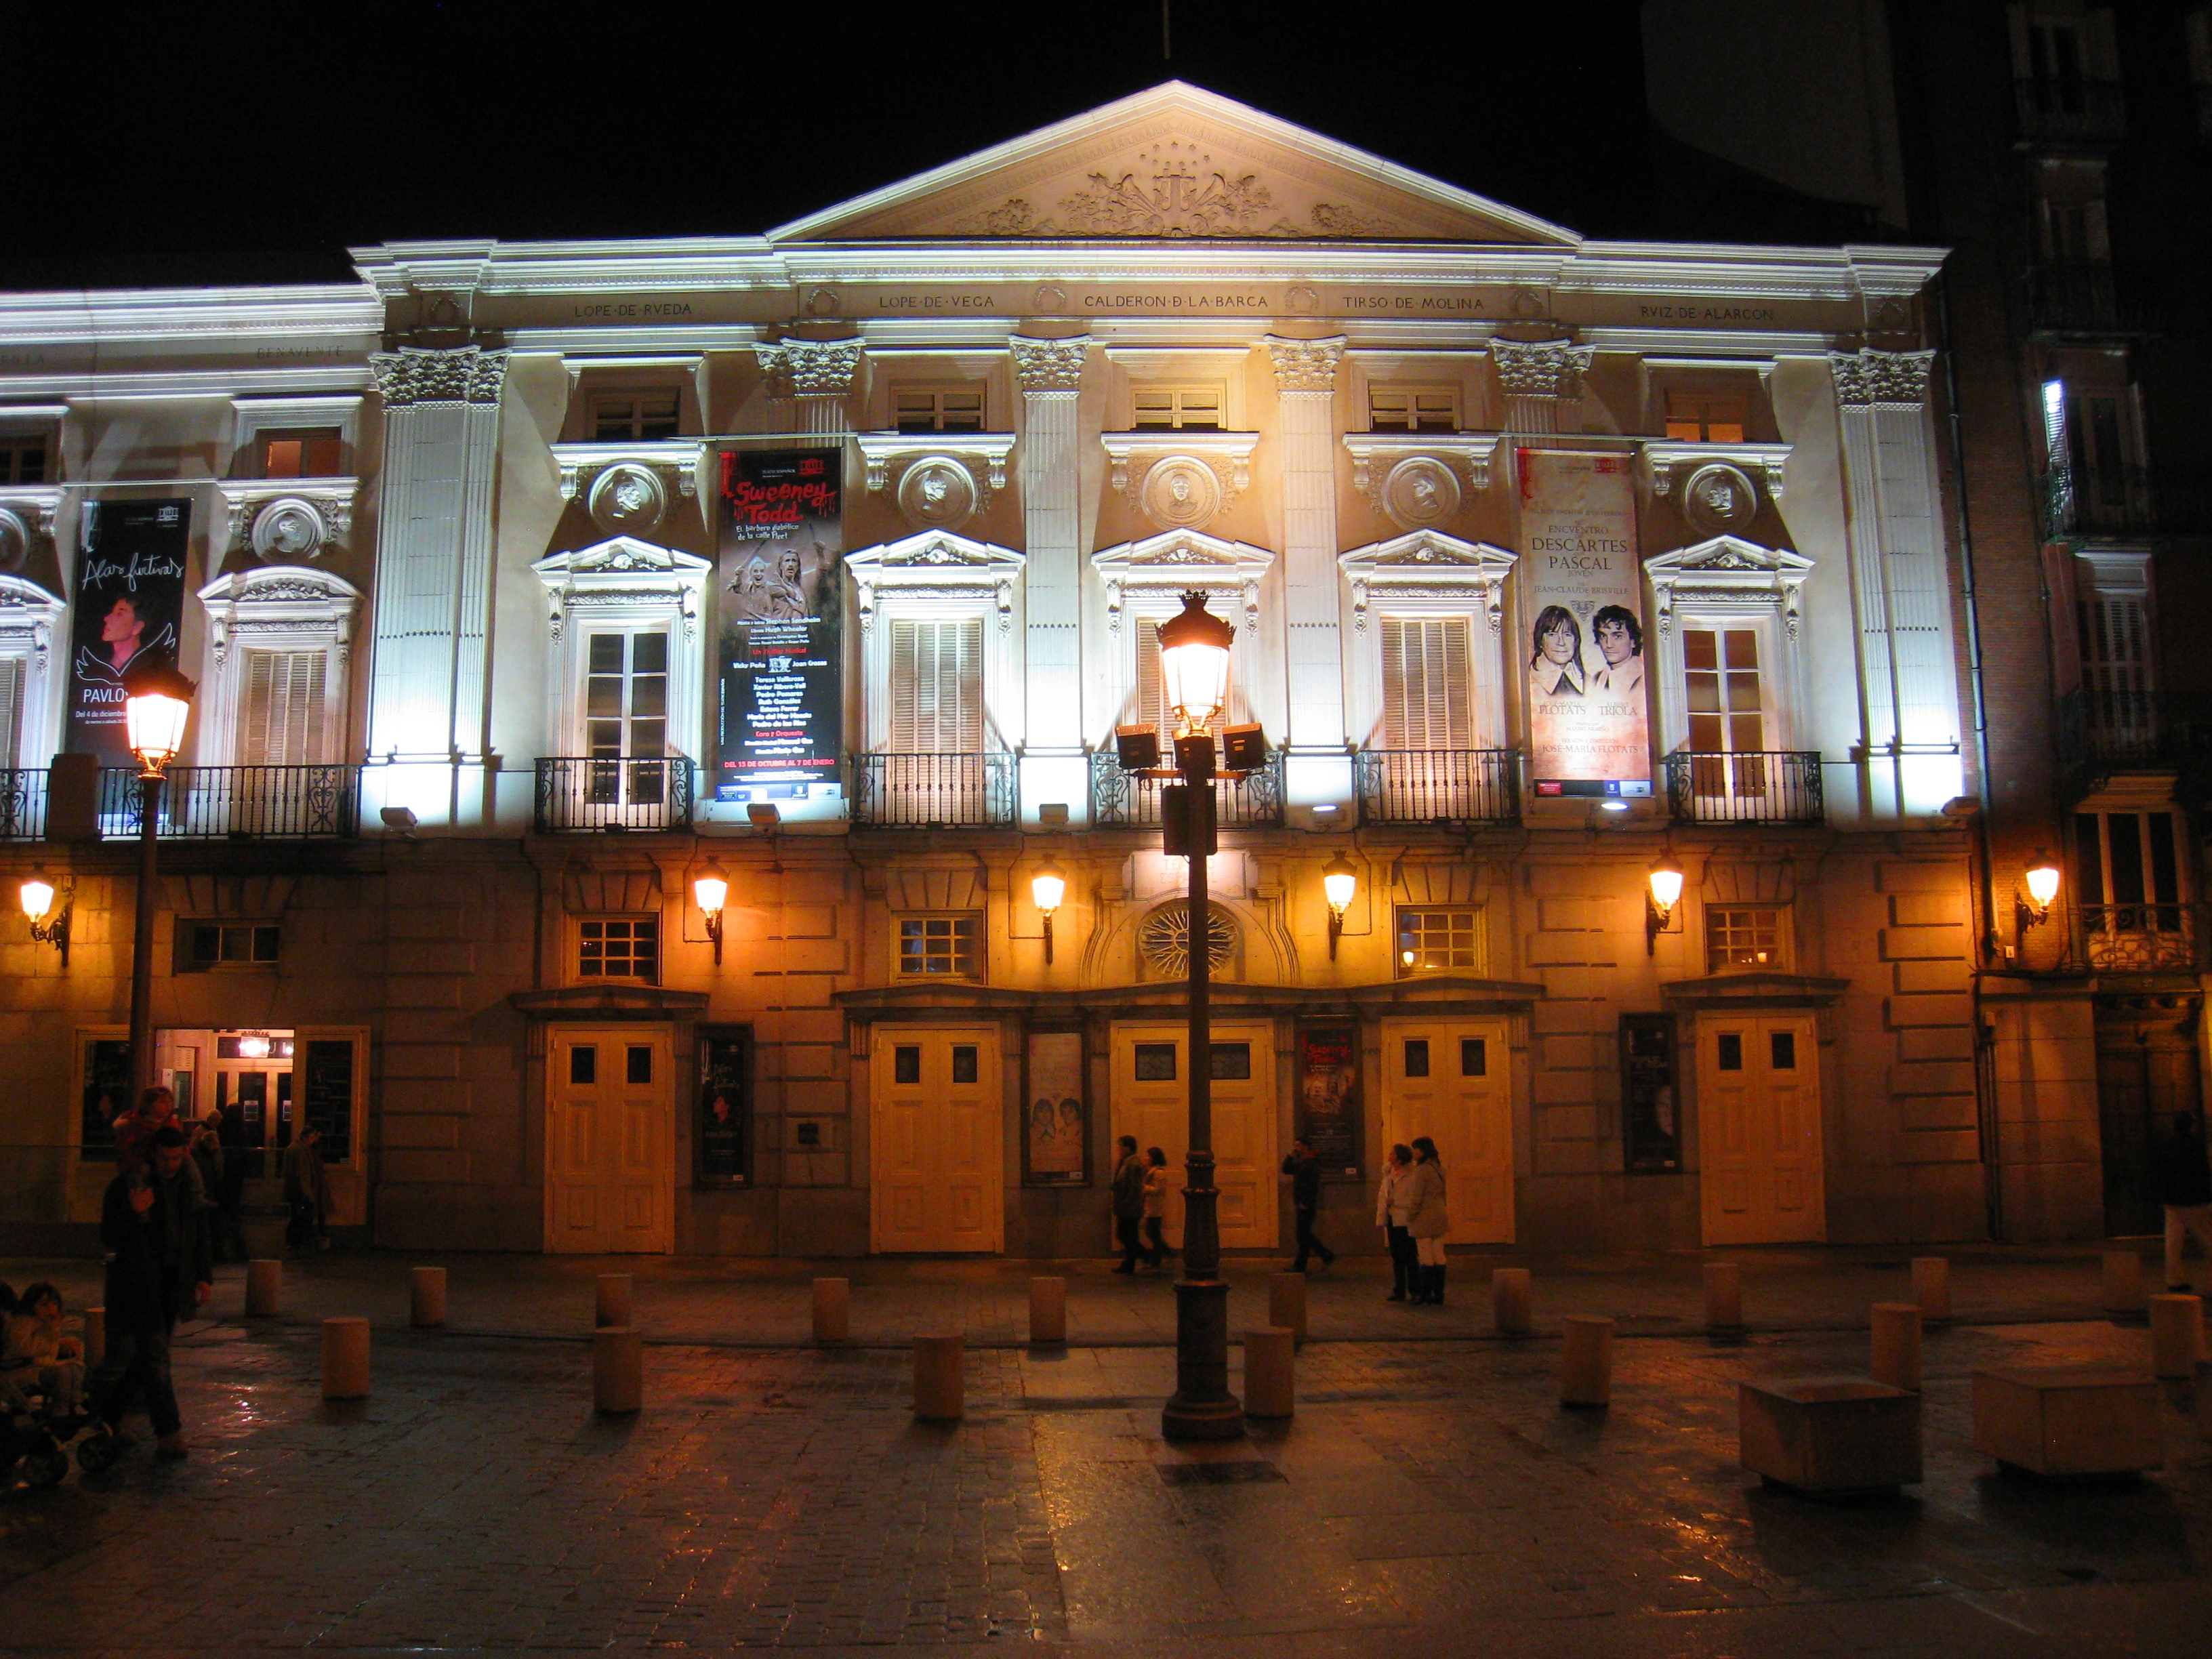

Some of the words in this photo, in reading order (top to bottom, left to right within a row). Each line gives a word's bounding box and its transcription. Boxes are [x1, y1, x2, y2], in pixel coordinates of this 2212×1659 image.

[879, 295, 918, 308] LOPE
[924, 295, 943, 308] DE
[951, 295, 995, 308] VEGA
[1084, 295, 1166, 308] CALDERON
[1188, 295, 1210, 308] LA
[1215, 295, 1269, 308] BARCA
[1343, 296, 1389, 308] TIRSO
[1395, 297, 1414, 309] DE
[1421, 297, 1485, 310] MOLINA
[575, 304, 612, 318] LOPE
[618, 304, 637, 316] DE
[643, 303, 693, 316] RVEDA
[1640, 306, 1673, 318] RVIZ
[1678, 306, 1697, 319] DE
[1704, 308, 1774, 321] ALARCON
[257, 345, 344, 359] BENAVENTE
[733, 482, 837, 508] Sweeney
[743, 501, 805, 525] Todd
[771, 531, 787, 540] Fleet
[1549, 526, 1608, 535] ENCVENTRO
[1532, 537, 1628, 553] DESCARTES
[1549, 556, 1612, 570] PASCAL
[82, 559, 125, 590] Alas
[1534, 586, 1589, 594] JEAN-CLAUDE
[83, 688, 129, 703] PAVLO
[1539, 705, 1586, 715] FLOTATS
[1598, 706, 1637, 716] TRIOLA
[1542, 743, 1596, 754] JOSÉ-MARÍA
[1598, 745, 1639, 754] FLOTATS
[1163, 858, 1214, 869] TEAO
